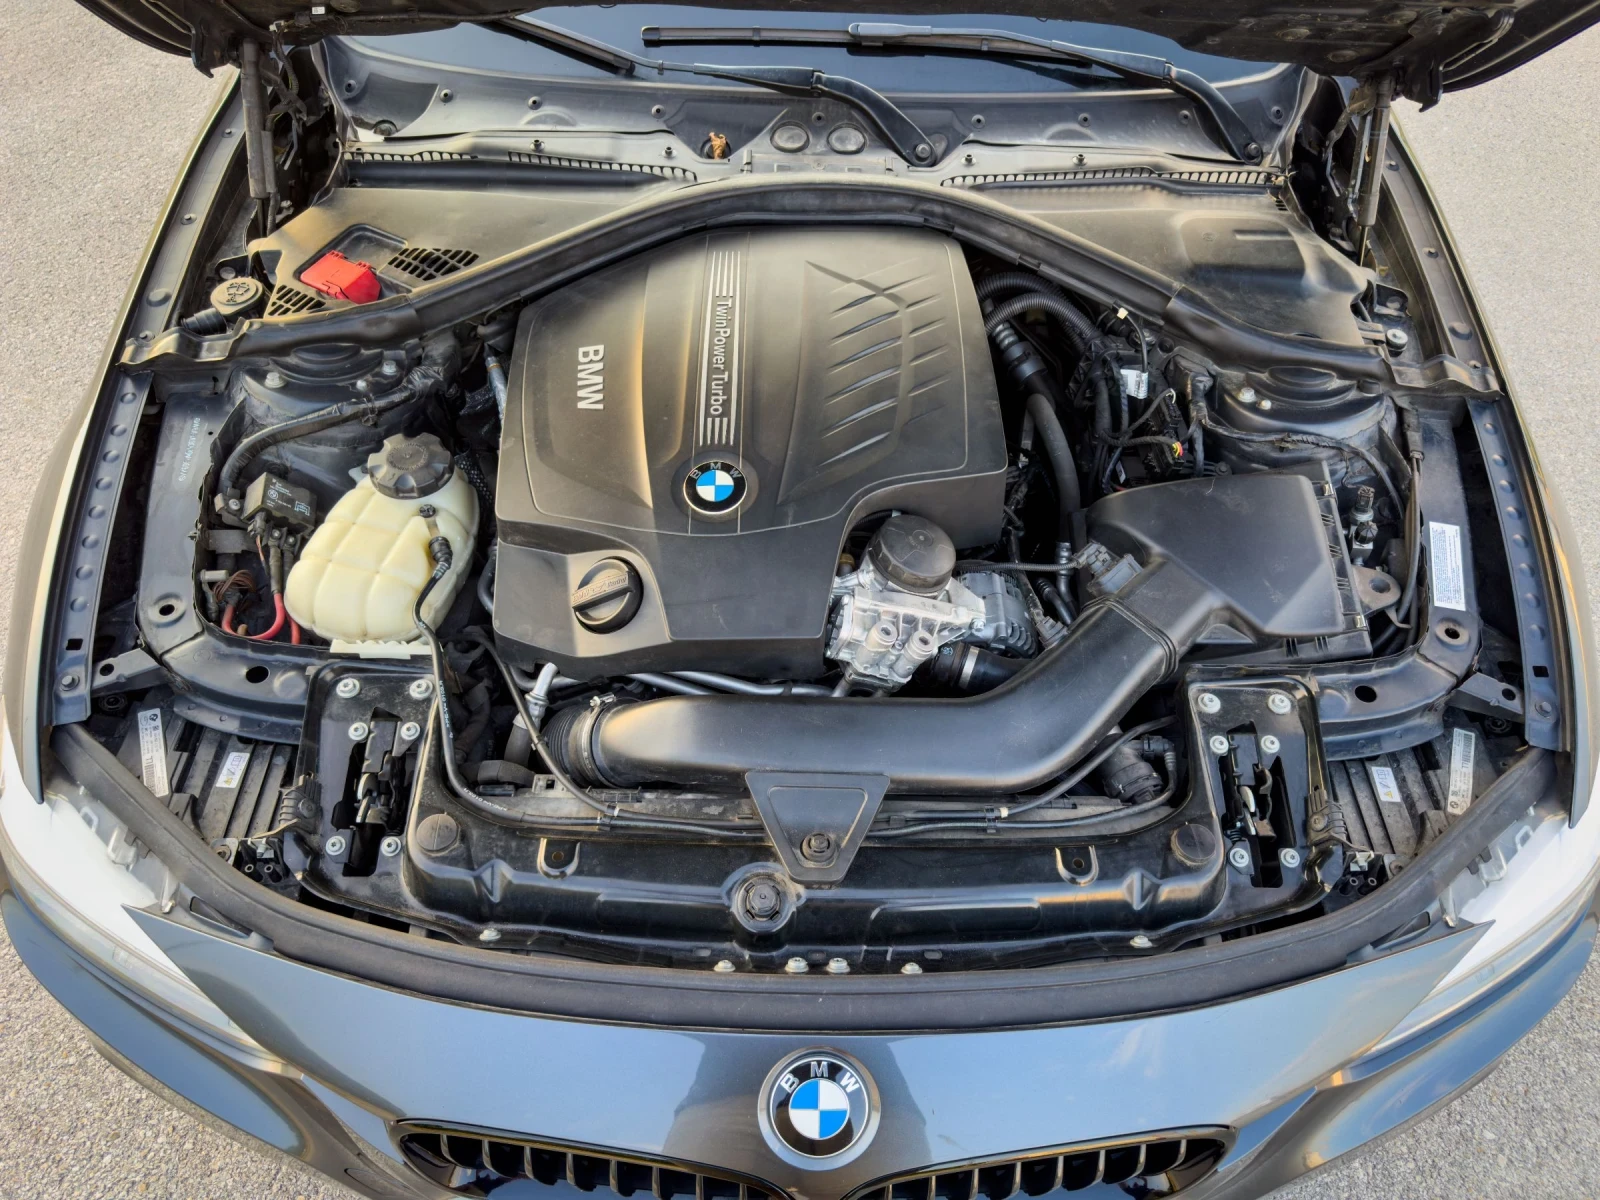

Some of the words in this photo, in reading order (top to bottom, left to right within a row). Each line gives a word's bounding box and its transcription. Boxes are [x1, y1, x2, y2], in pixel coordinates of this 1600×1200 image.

[712, 297, 733, 370] TwinPower
[577, 344, 605, 410] BMW
[709, 371, 729, 416] Turbo
[690, 462, 743, 480] BMW
[780, 1061, 860, 1093] BMW
